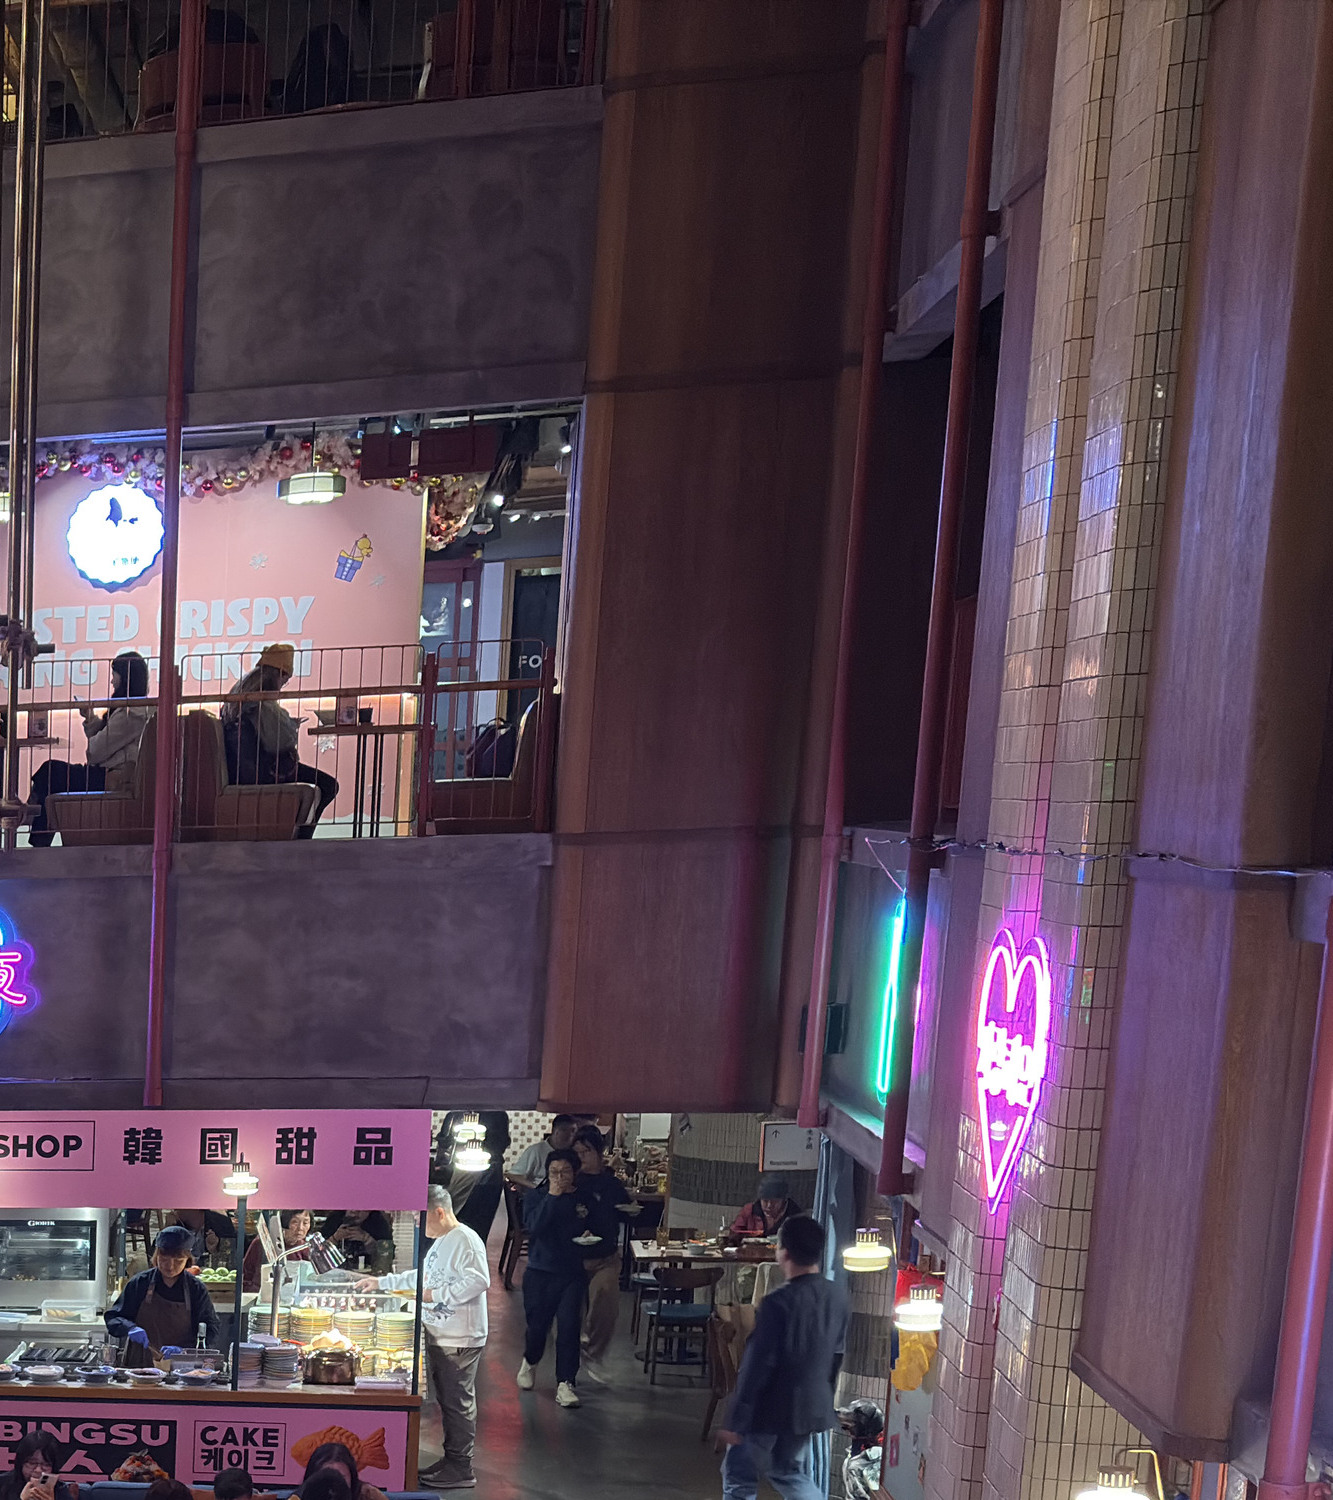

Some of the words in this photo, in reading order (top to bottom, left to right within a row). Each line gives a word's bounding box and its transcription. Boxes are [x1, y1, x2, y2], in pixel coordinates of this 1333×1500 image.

[156, 596, 316, 639] RISPY
[122, 1126, 394, 1166] 韓國甜品
[199, 1425, 280, 1448] CAKE
[199, 1447, 277, 1472] 케이크
